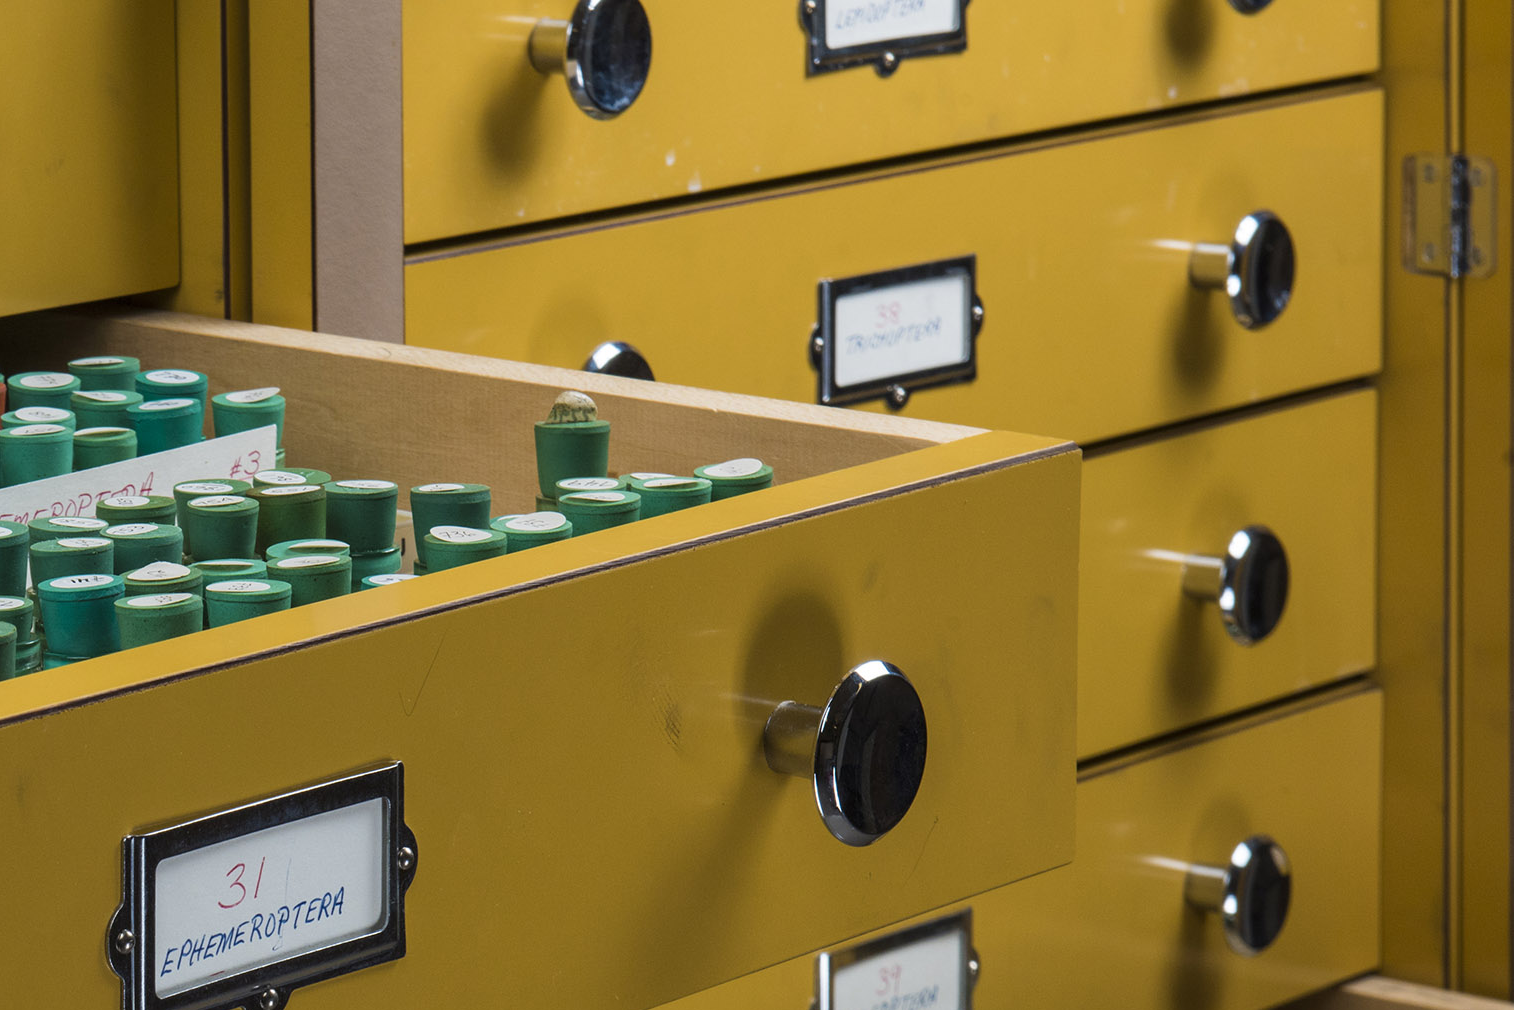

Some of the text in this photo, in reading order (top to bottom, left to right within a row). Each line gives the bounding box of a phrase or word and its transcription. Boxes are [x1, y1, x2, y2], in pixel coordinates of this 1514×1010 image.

[230, 451, 261, 478] #3
[217, 856, 266, 909] 31
[160, 886, 345, 978] EPHEMEROPTERA
